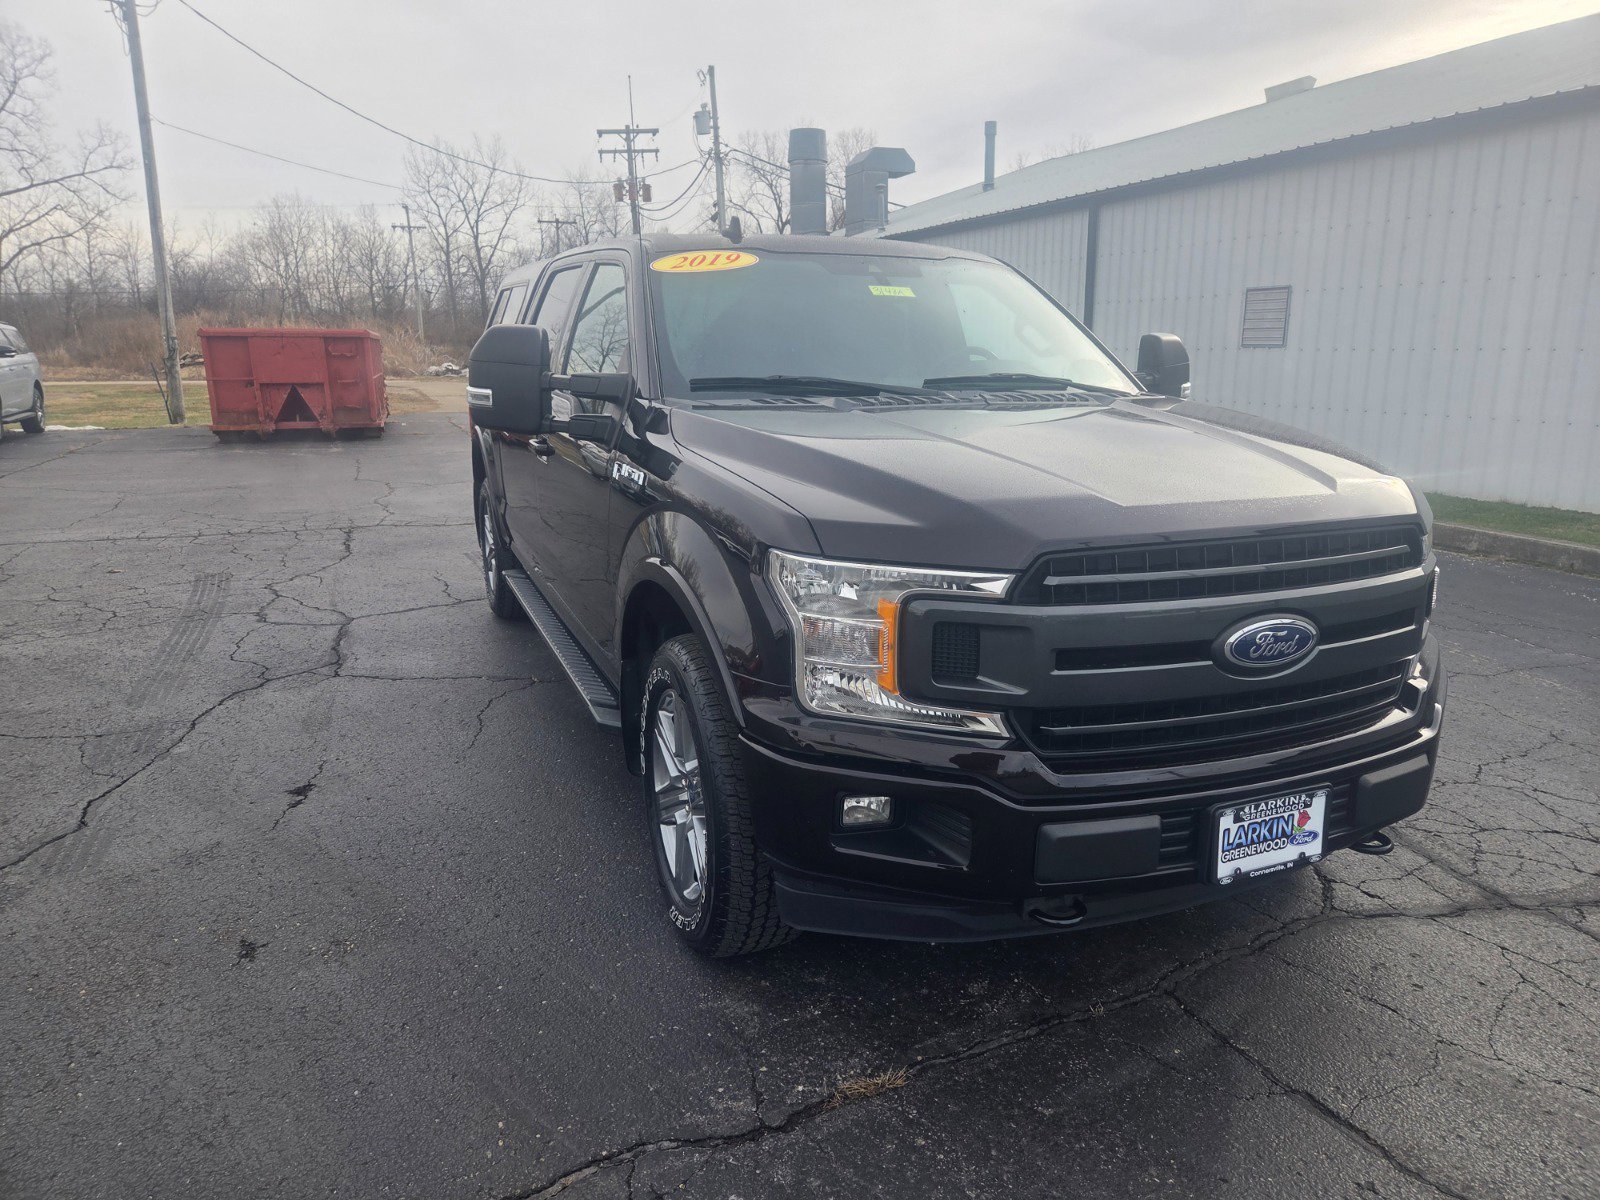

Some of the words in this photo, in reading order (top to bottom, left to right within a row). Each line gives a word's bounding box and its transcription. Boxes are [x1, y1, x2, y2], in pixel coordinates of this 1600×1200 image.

[670, 253, 741, 270] 2019
[1249, 630, 1300, 658] Ford
[1244, 803, 1305, 820] GREENEWOOD
[1250, 795, 1299, 813] LARKIN
[1222, 814, 1295, 851] LARKIN
[1292, 832, 1315, 845] Ford
[1221, 838, 1288, 863] GREENEWOOD
